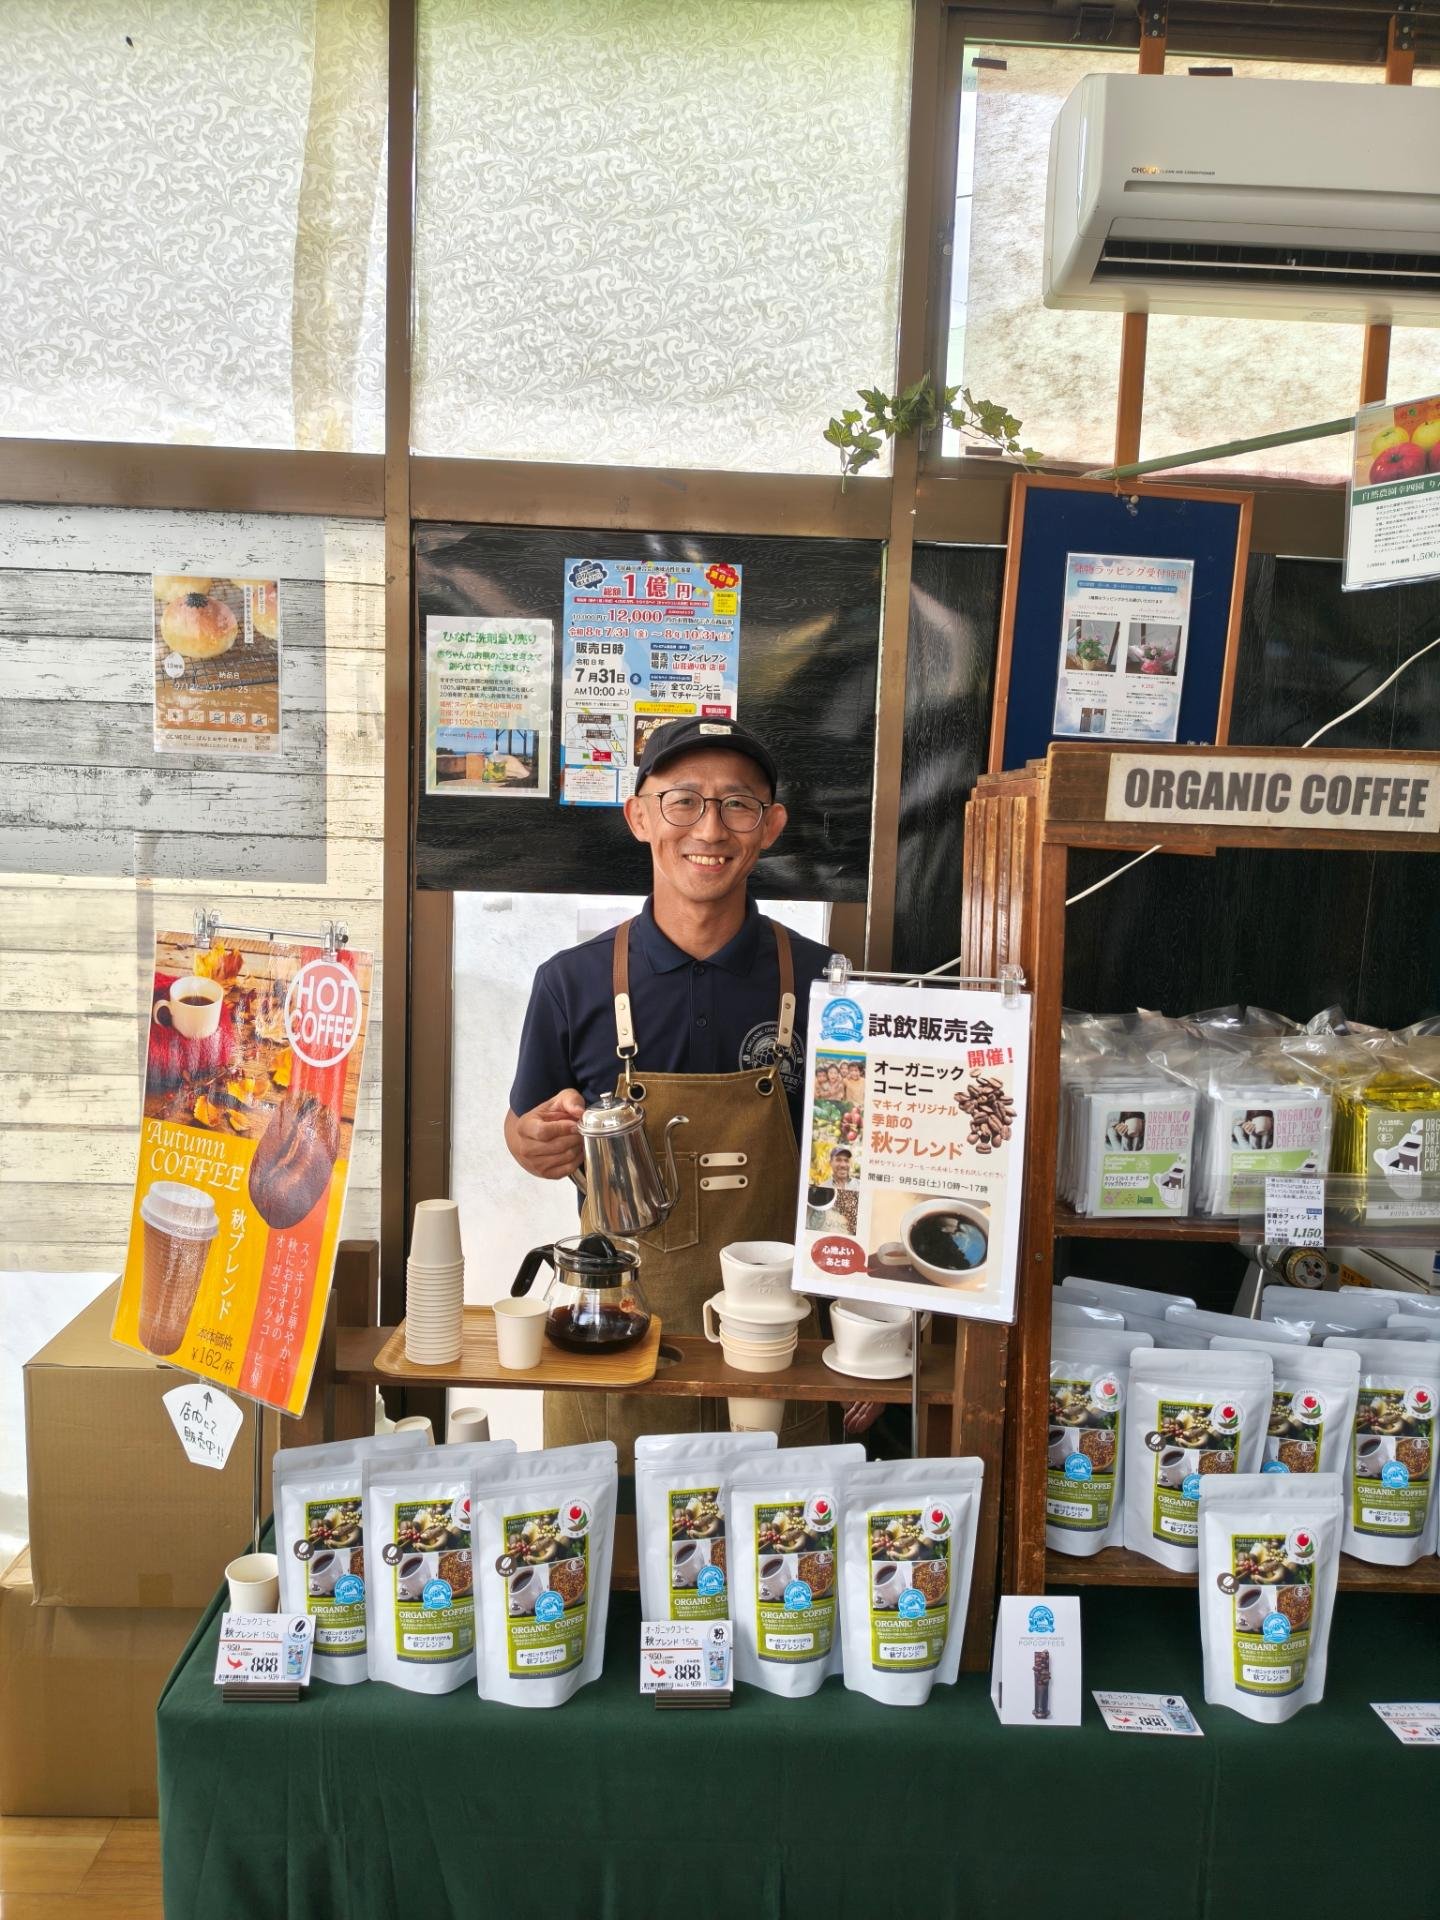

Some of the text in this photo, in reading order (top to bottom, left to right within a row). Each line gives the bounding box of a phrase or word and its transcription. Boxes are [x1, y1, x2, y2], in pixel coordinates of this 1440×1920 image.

[607, 609, 663, 623] 12,000
[575, 642, 624, 655] 販売日時
[672, 653, 727, 662] セブンイレブン
[575, 668, 625, 683] 7月31日
[671, 683, 721, 692] 全てのコンビニ
[1124, 768, 1430, 818] ORGANIC COFFEE
[297, 976, 356, 1010] HOT
[289, 1010, 354, 1048] COFFEE
[868, 1013, 994, 1045] 試飲販売会
[873, 1060, 964, 1081] オーガニック
[873, 1080, 933, 1097] コーヒー
[872, 1100, 958, 1117] マキイ オリジナル
[1277, 1107, 1314, 1121] ORGANIC
[871, 1114, 912, 1130] 季節の
[1147, 1111, 1182, 1123] ORGANIC
[1169, 1124, 1189, 1137] PACK
[1301, 1120, 1321, 1134] PACK
[147, 1121, 227, 1158] Autumn
[871, 1131, 963, 1160] 秋ブレンド
[150, 1149, 245, 1191] COFFEE
[1293, 1228, 1321, 1238] 1,150
[822, 1245, 854, 1256] 心地よい
[219, 1208, 247, 1320] 秋ブレンド
[825, 1258, 851, 1268] あと味
[272, 1238, 298, 1339] 秋におすすめの
[180, 1401, 217, 1436] 店内にて
[1047, 1479, 1111, 1490] RGANIC COFFEE
[1358, 1487, 1396, 1496] ORGANIC
[1158, 1495, 1196, 1507] ORGANIC
[1054, 1509, 1083, 1517] 秋ブレンド
[1375, 1515, 1405, 1523] 秋ブレンド
[674, 1597, 711, 1606] ORGANIC
[311, 1605, 349, 1614] ORGANIC
[399, 1606, 474, 1619] ORGANIC COFFEE
[760, 1607, 832, 1619] ORGANIC COFFEE
[226, 1616, 278, 1626] オーガニックコーヒー
[511, 1616, 585, 1634] ORGANIC COFFEE
[875, 1617, 945, 1628] ORGANIC COFFEE
[225, 1628, 259, 1639] 秋ブレンド
[646, 1625, 694, 1634] オーガニックコーヒー
[713, 1628, 724, 1640] 粉
[325, 1634, 357, 1642] 秋ブレンド
[413, 1640, 444, 1648] 秋ブレンド
[645, 1636, 679, 1646] 秋ブレンド
[774, 1642, 806, 1650] 秋ブレンド
[1237, 1641, 1307, 1651] ORGANIC COFFEE
[526, 1655, 558, 1664] 秋ブレンド
[890, 1650, 921, 1658] 秋ブレンド
[251, 1657, 278, 1672] 888
[674, 1664, 701, 1680] 888
[1253, 1673, 1285, 1681] 秋ブレンド
